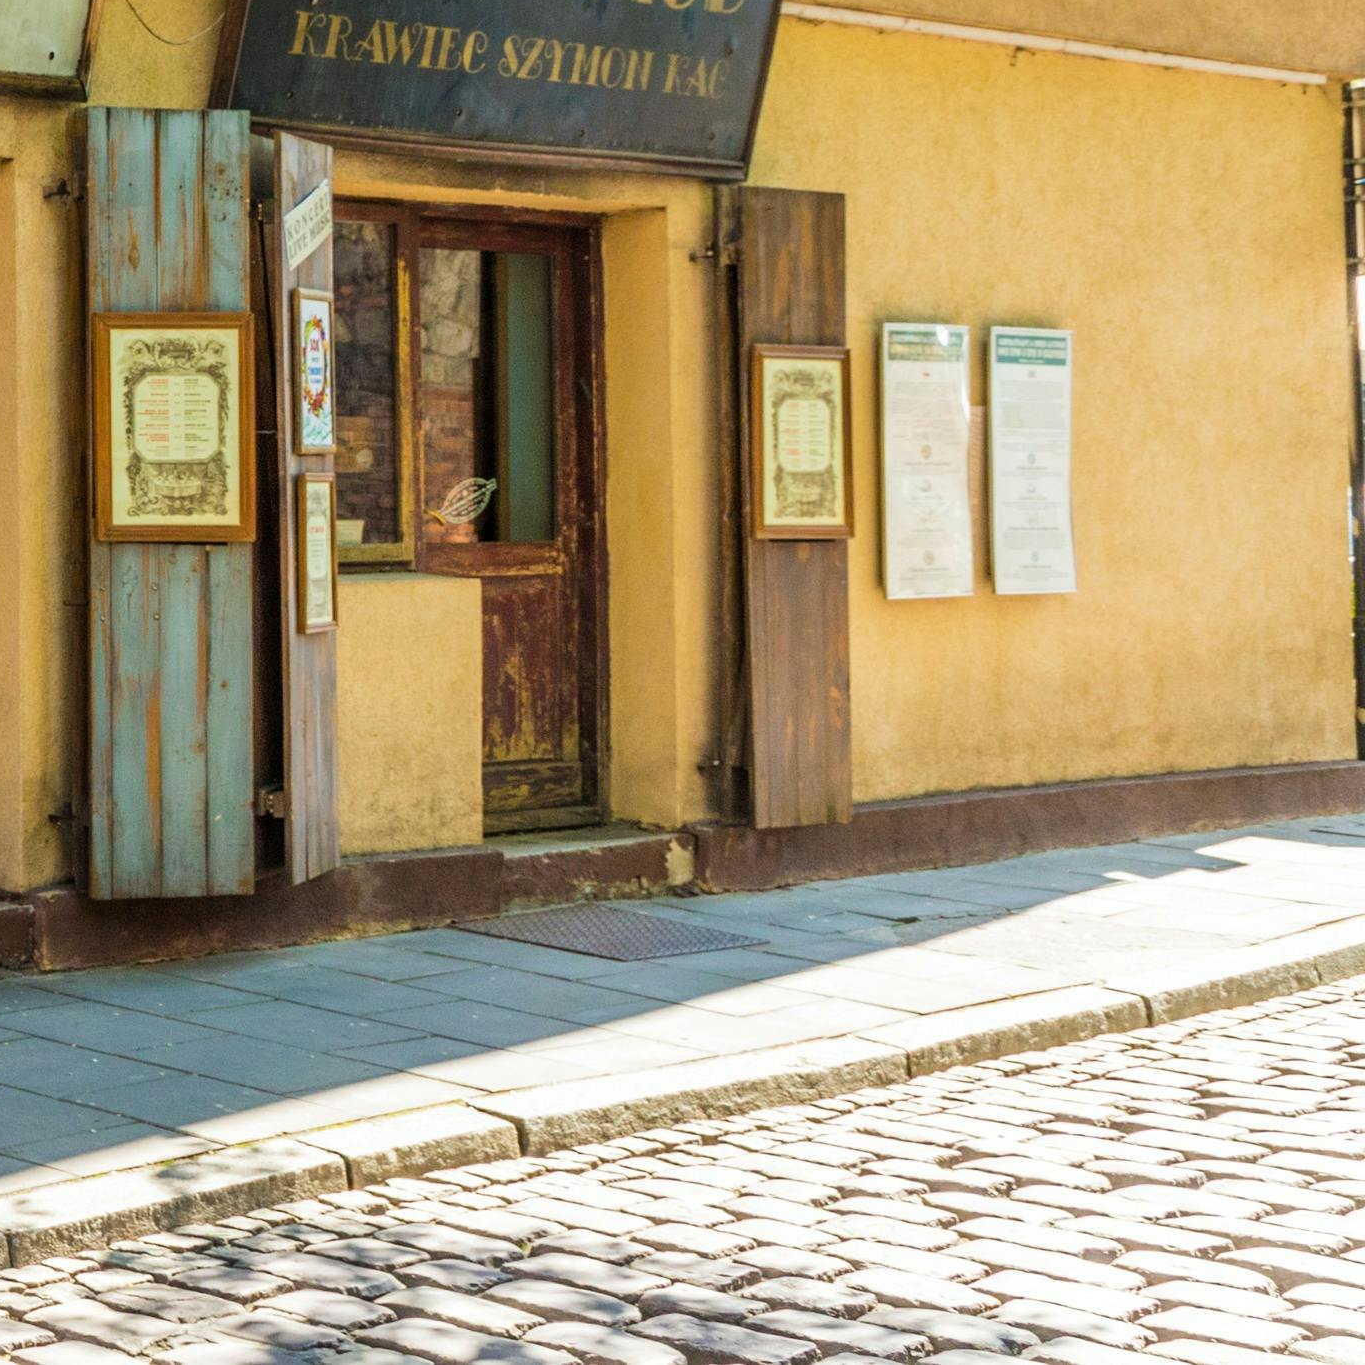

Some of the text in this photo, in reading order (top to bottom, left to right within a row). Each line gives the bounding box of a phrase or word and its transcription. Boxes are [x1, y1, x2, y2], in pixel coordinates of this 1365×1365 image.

[287, 11, 489, 75] KRAWIEC
[498, 34, 655, 92] SZYMON
[288, 232, 309, 260] LIVE
